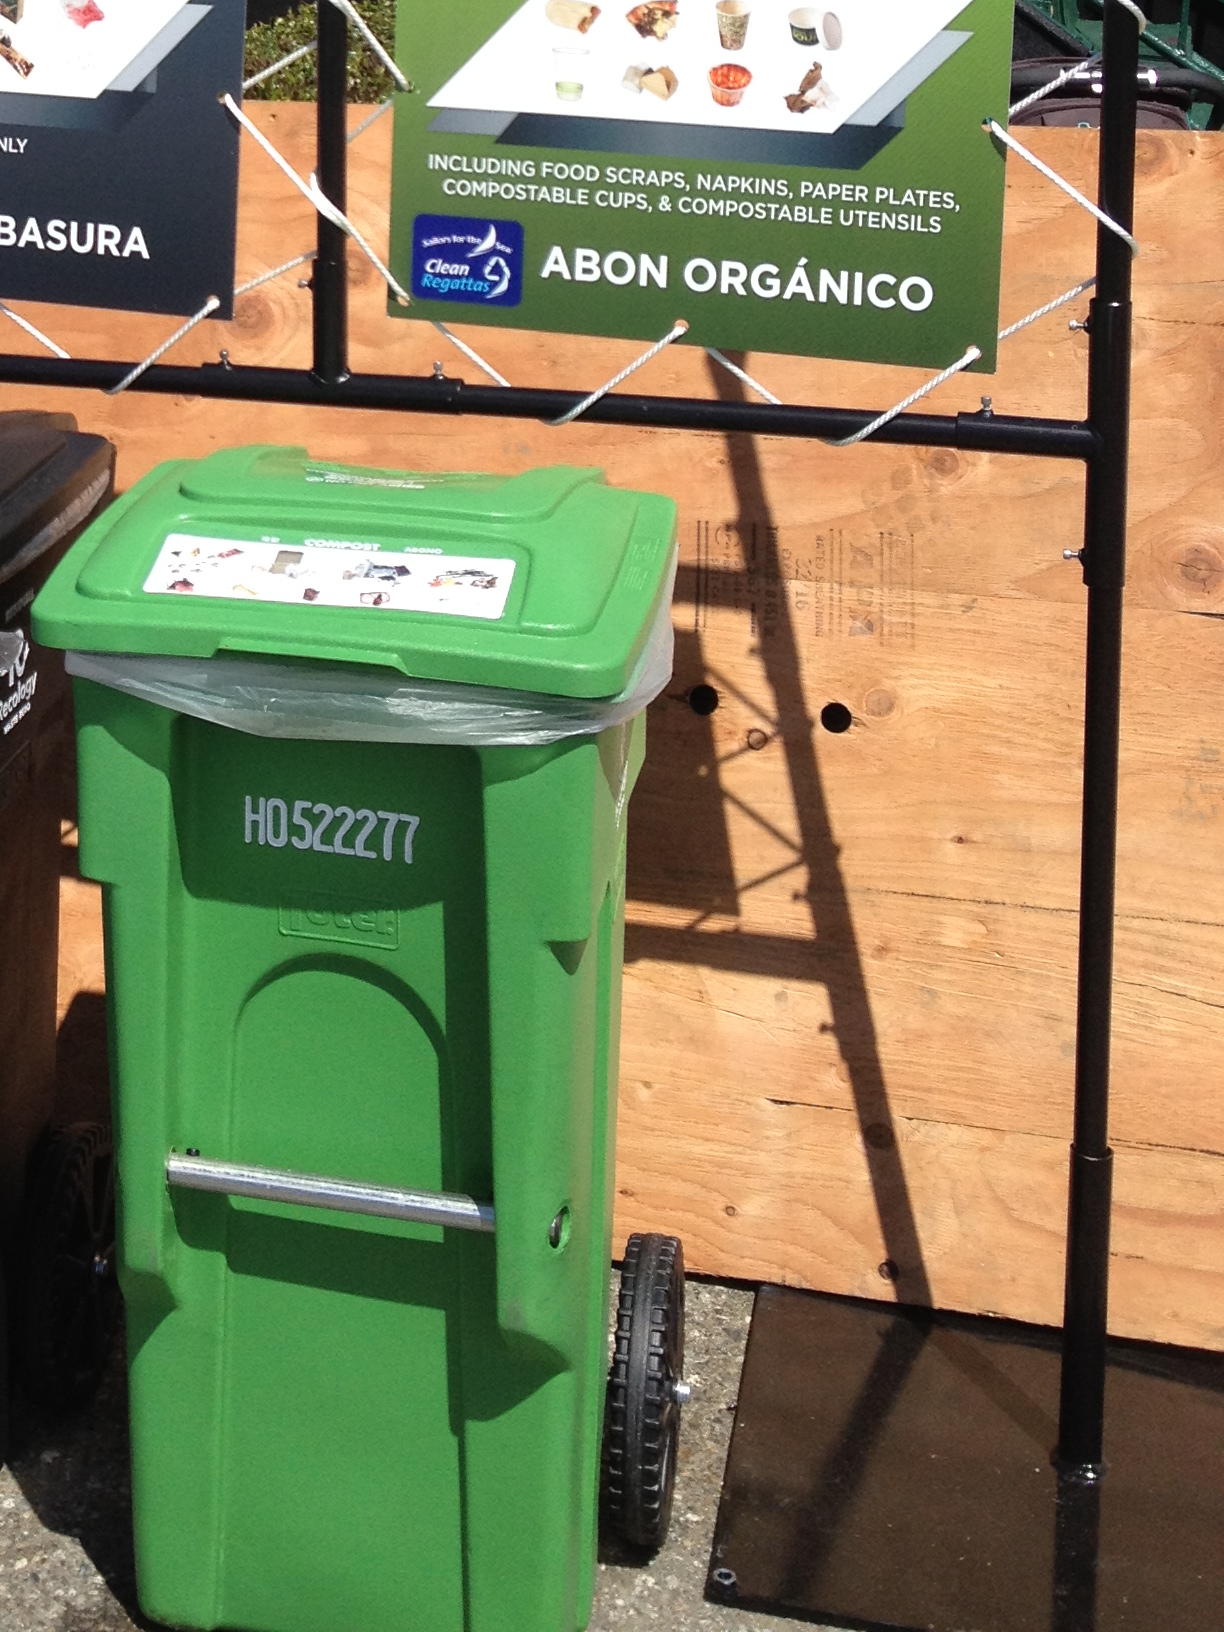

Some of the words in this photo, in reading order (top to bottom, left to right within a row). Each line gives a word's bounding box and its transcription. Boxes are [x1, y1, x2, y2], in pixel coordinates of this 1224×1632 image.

[427, 153, 536, 178] INCLUDING
[541, 161, 600, 182] FOOD
[605, 166, 691, 192] SCRAPS,
[696, 173, 794, 200] NAPKINS,
[799, 181, 869, 203] PAPER
[874, 186, 961, 213] PLATES,
[442, 178, 590, 206] COMPOSTABLE
[594, 190, 653, 214] CUPS,
[657, 195, 673, 212] &
[678, 196, 833, 225] COMPOSTABLE
[838, 208, 942, 234] UTENSILS
[421, 273, 491, 294] Regattas
[424, 258, 471, 277] Clean
[540, 245, 669, 290] ABON
[682, 256, 935, 312] ORGÁNICO
[303, 538, 382, 552] COMPOST
